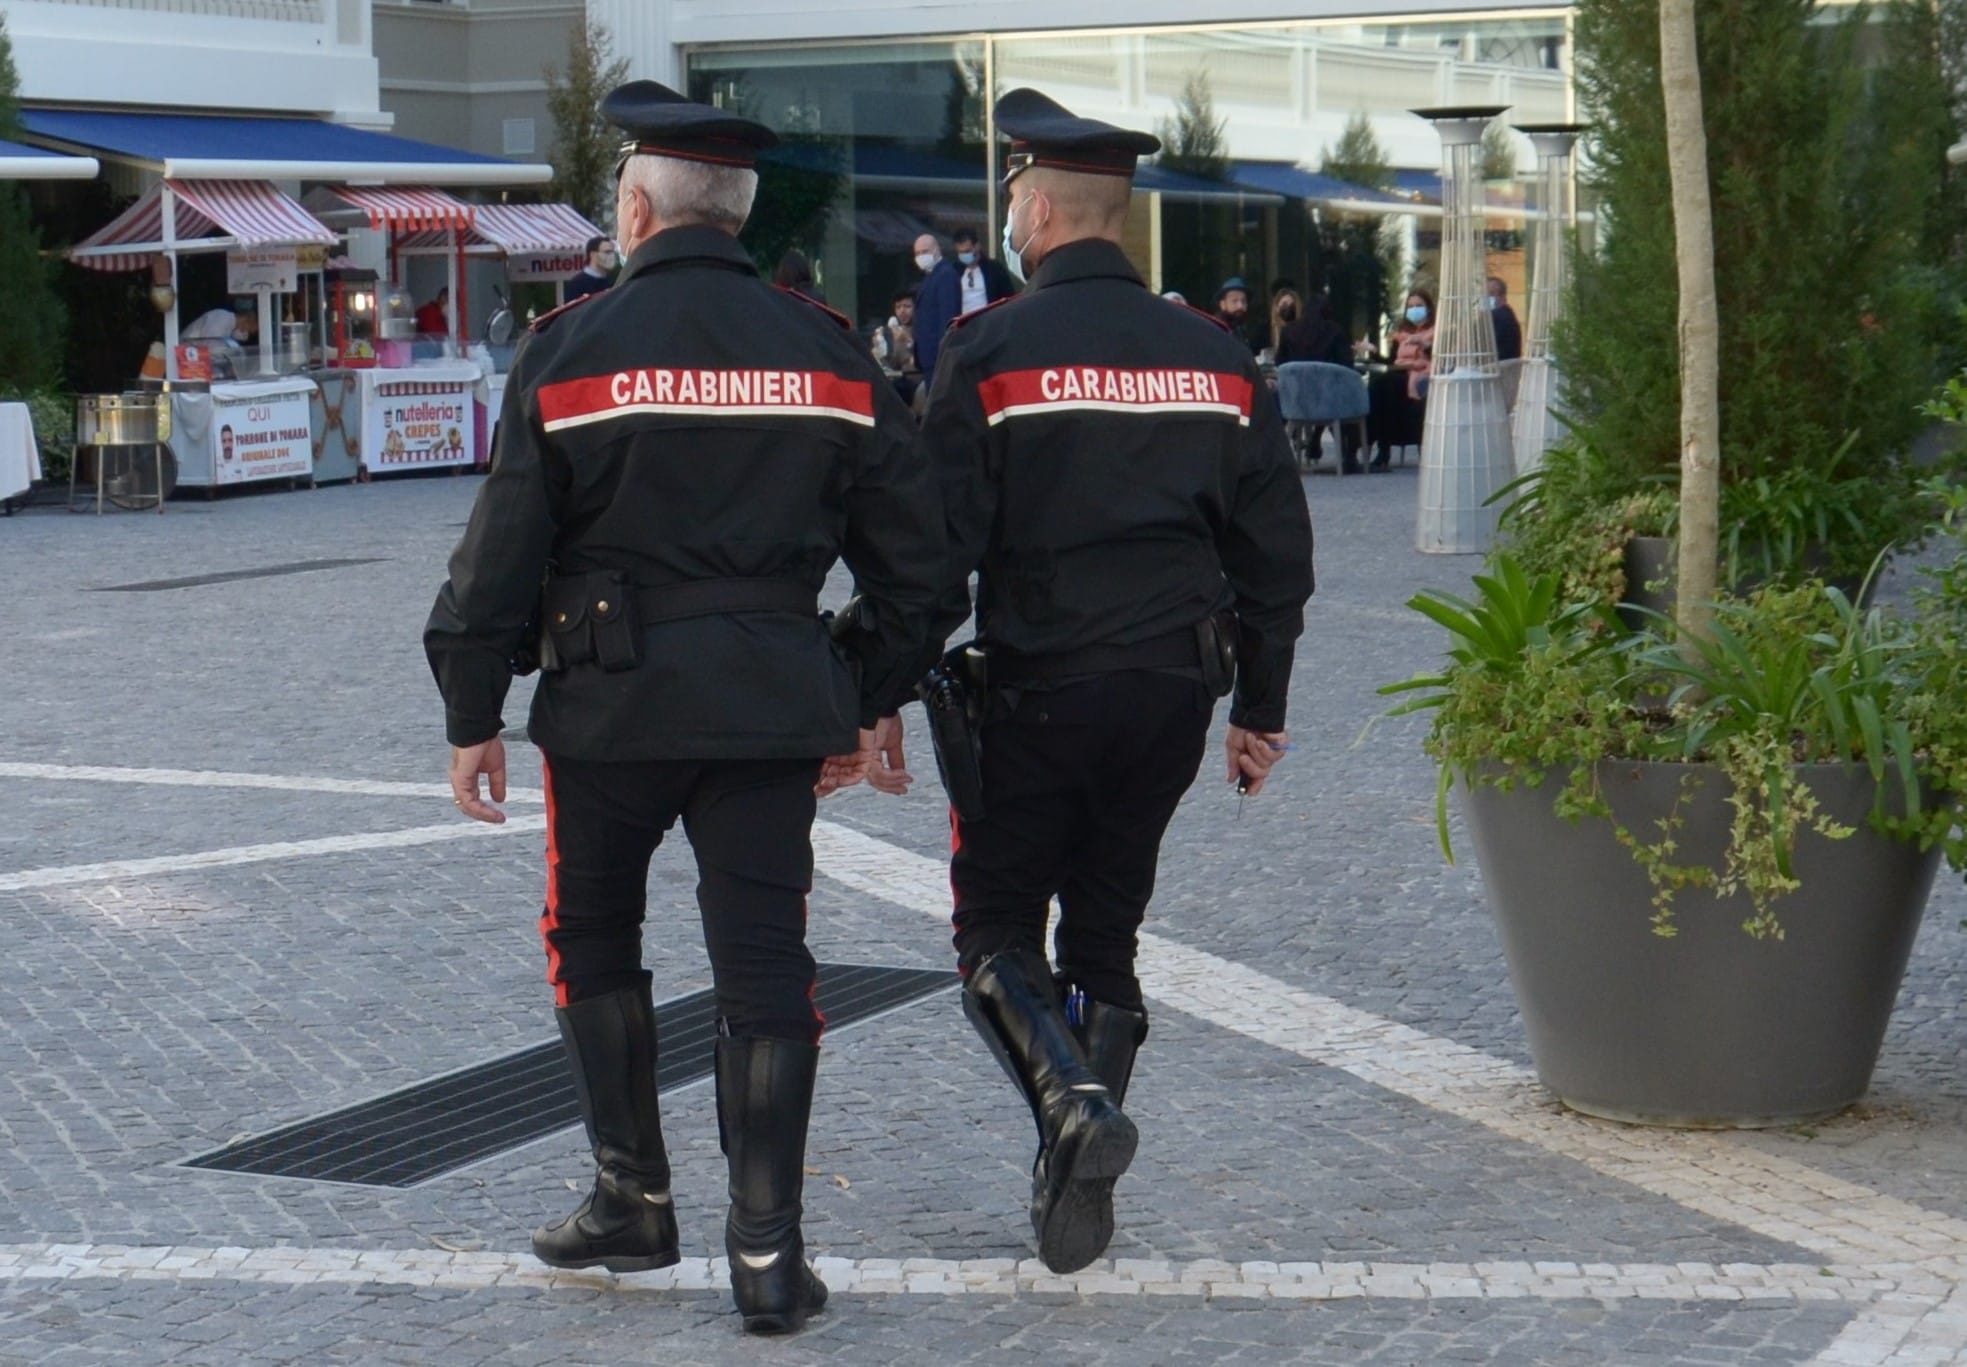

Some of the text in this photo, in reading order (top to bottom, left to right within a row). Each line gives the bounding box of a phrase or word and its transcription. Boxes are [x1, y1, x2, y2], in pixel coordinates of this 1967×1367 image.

[610, 370, 813, 405] CARABINIERI
[1041, 368, 1219, 402] CARABINIERI
[247, 407, 271, 422] QUI
[395, 401, 454, 422] nutelleria
